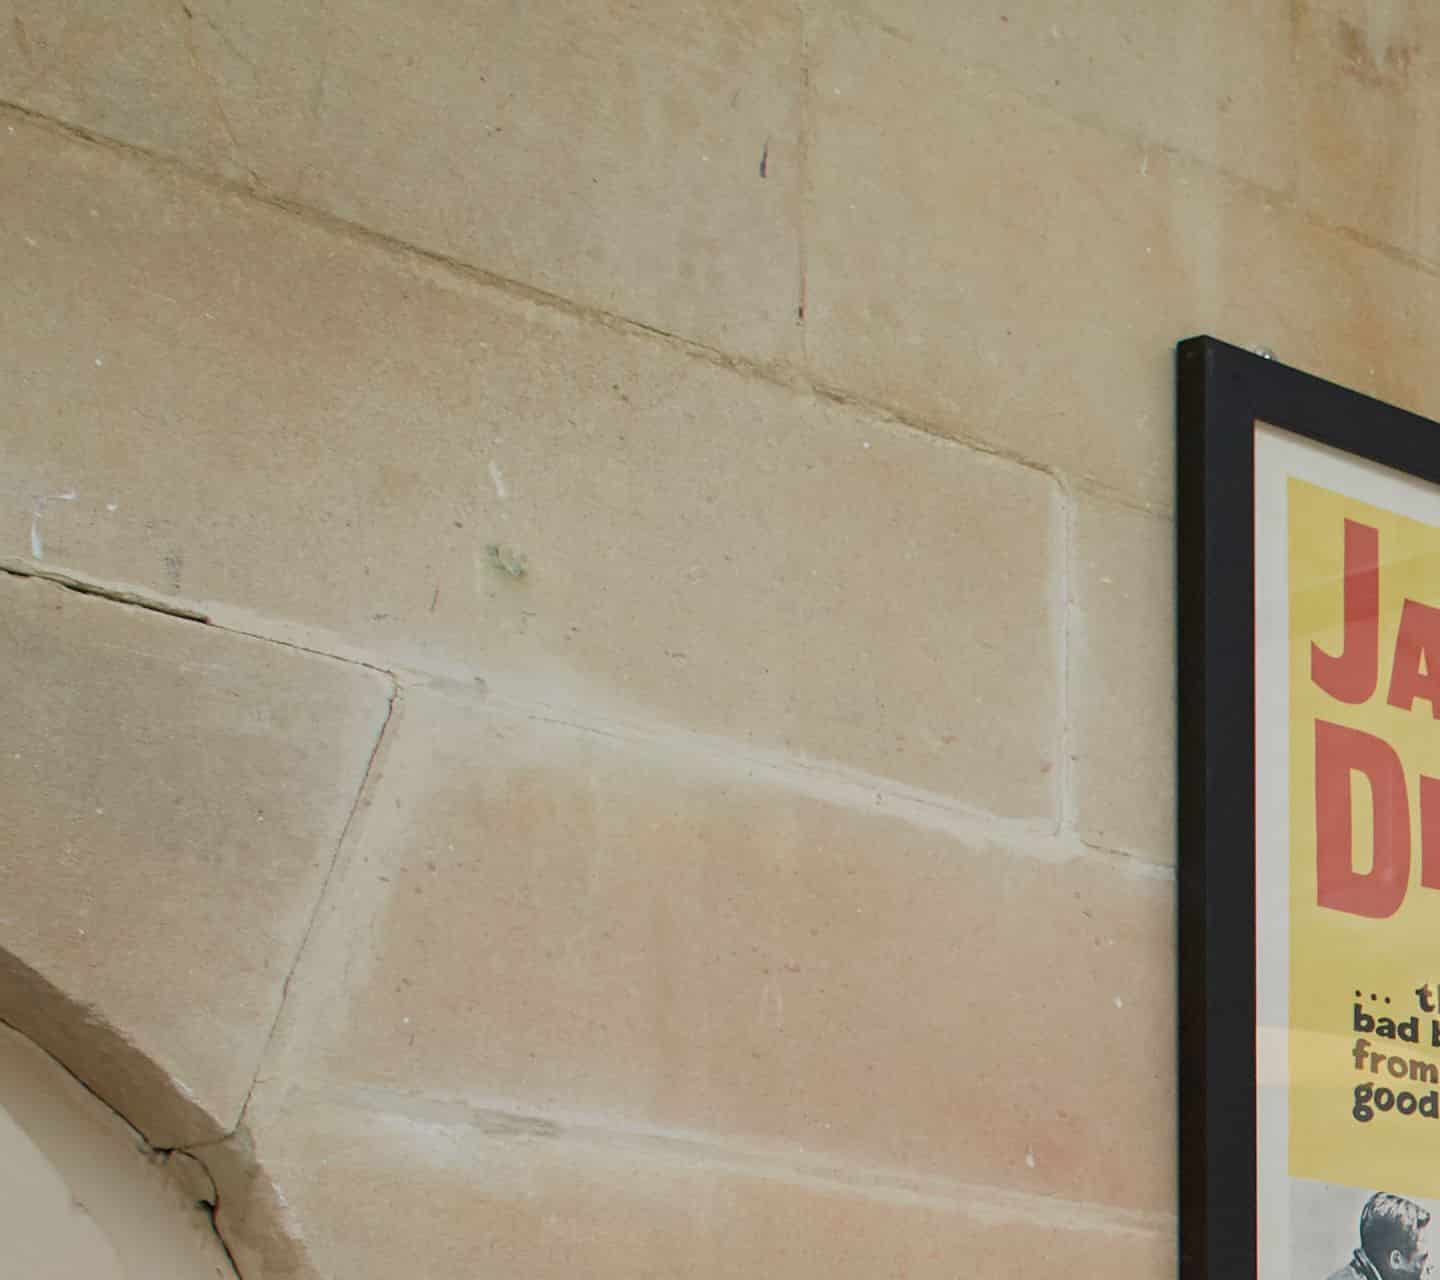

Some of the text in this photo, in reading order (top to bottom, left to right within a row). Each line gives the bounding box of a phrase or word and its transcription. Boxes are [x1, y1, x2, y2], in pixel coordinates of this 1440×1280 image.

[1352, 1002, 1420, 1043] bad
[1352, 1038, 1439, 1085] from
[1352, 1081, 1440, 1123] good
